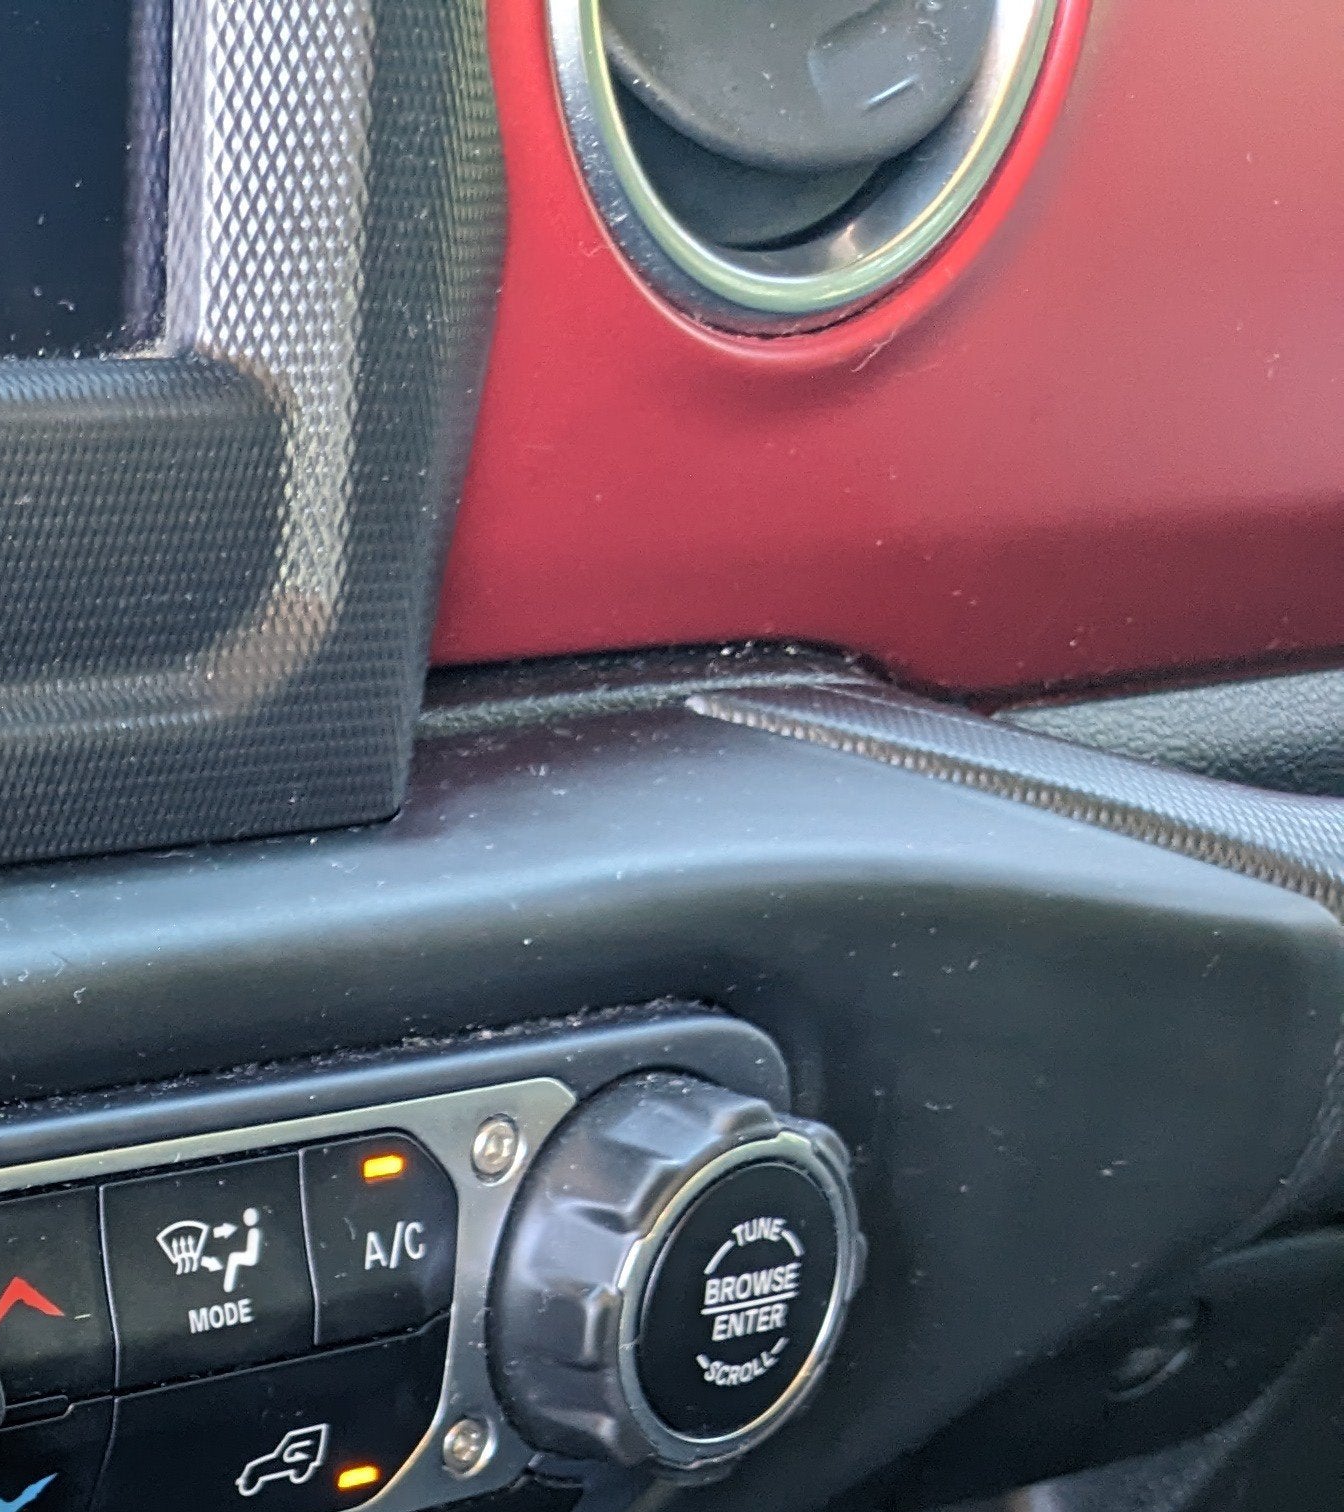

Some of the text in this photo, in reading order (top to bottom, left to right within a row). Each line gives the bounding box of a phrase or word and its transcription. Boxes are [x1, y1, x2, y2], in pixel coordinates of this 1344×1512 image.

[364, 1221, 426, 1270] A/C
[731, 1216, 786, 1247] TUNE
[704, 1263, 801, 1305] BROWSE
[189, 1298, 253, 1334] MODE
[712, 1303, 787, 1341] ENTER
[703, 1351, 779, 1386] SCROLL
